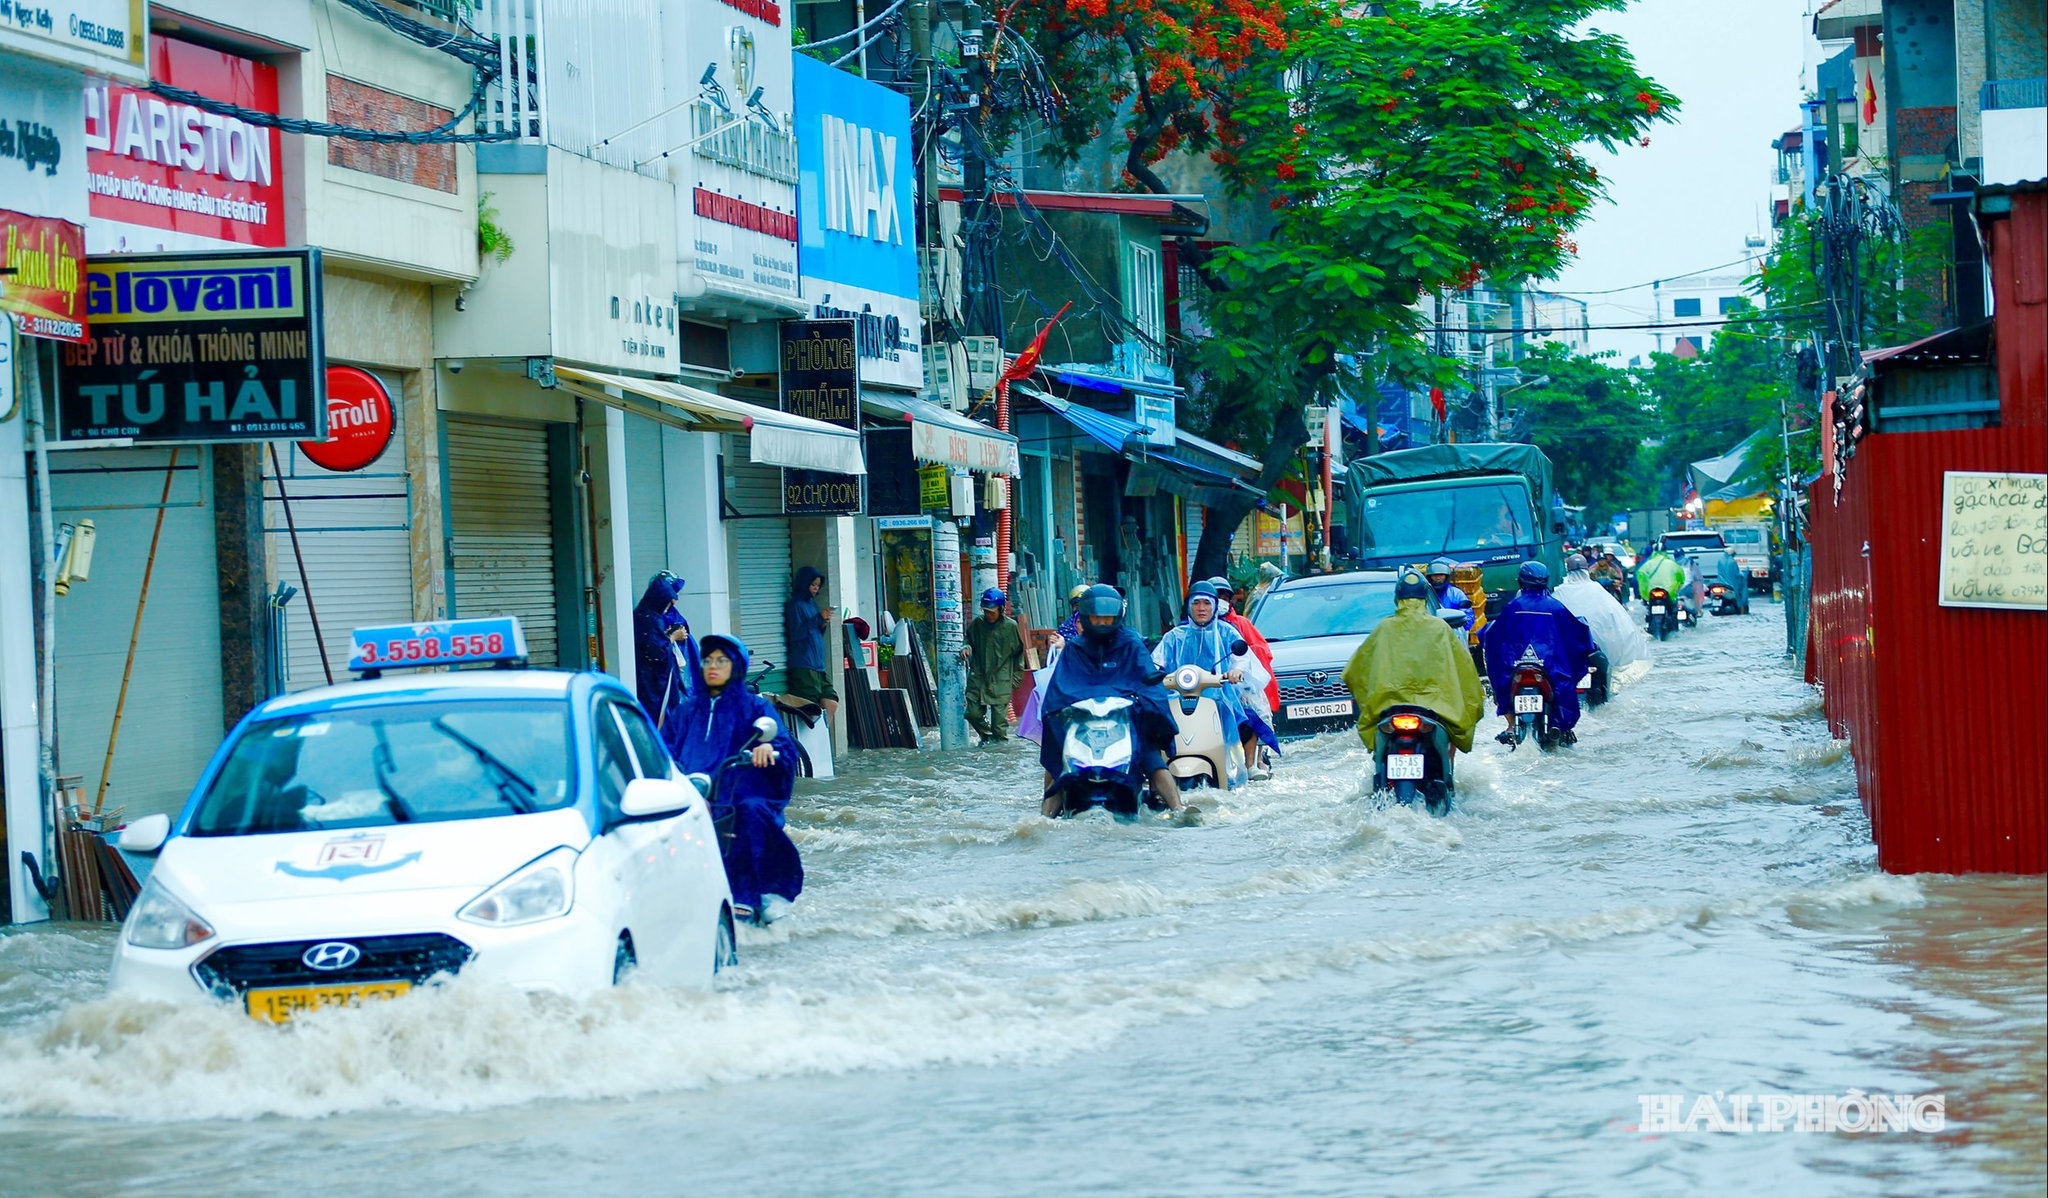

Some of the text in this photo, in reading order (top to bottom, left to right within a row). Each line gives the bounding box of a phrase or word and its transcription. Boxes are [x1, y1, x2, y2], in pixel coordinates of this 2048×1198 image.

[113, 93, 272, 187] ARISTON
[97, 170, 121, 197] PHÁP
[122, 175, 147, 203] NƯỚC
[148, 179, 172, 207] NÓNG
[173, 184, 197, 212] HÀNG
[822, 113, 903, 246] INAX
[102, 330, 126, 366] TỪ
[130, 336, 142, 365] &
[147, 329, 194, 363] KHÓA
[197, 328, 255, 362] THÔNG
[260, 330, 307, 360] MINH
[784, 331, 854, 371] PHÒNG
[79, 365, 296, 425] TÚ HẢI
[327, 398, 379, 430] rroli
[788, 382, 850, 420] KHÁM
[788, 485, 803, 505] 92
[361, 633, 503, 664] 3.558.558
